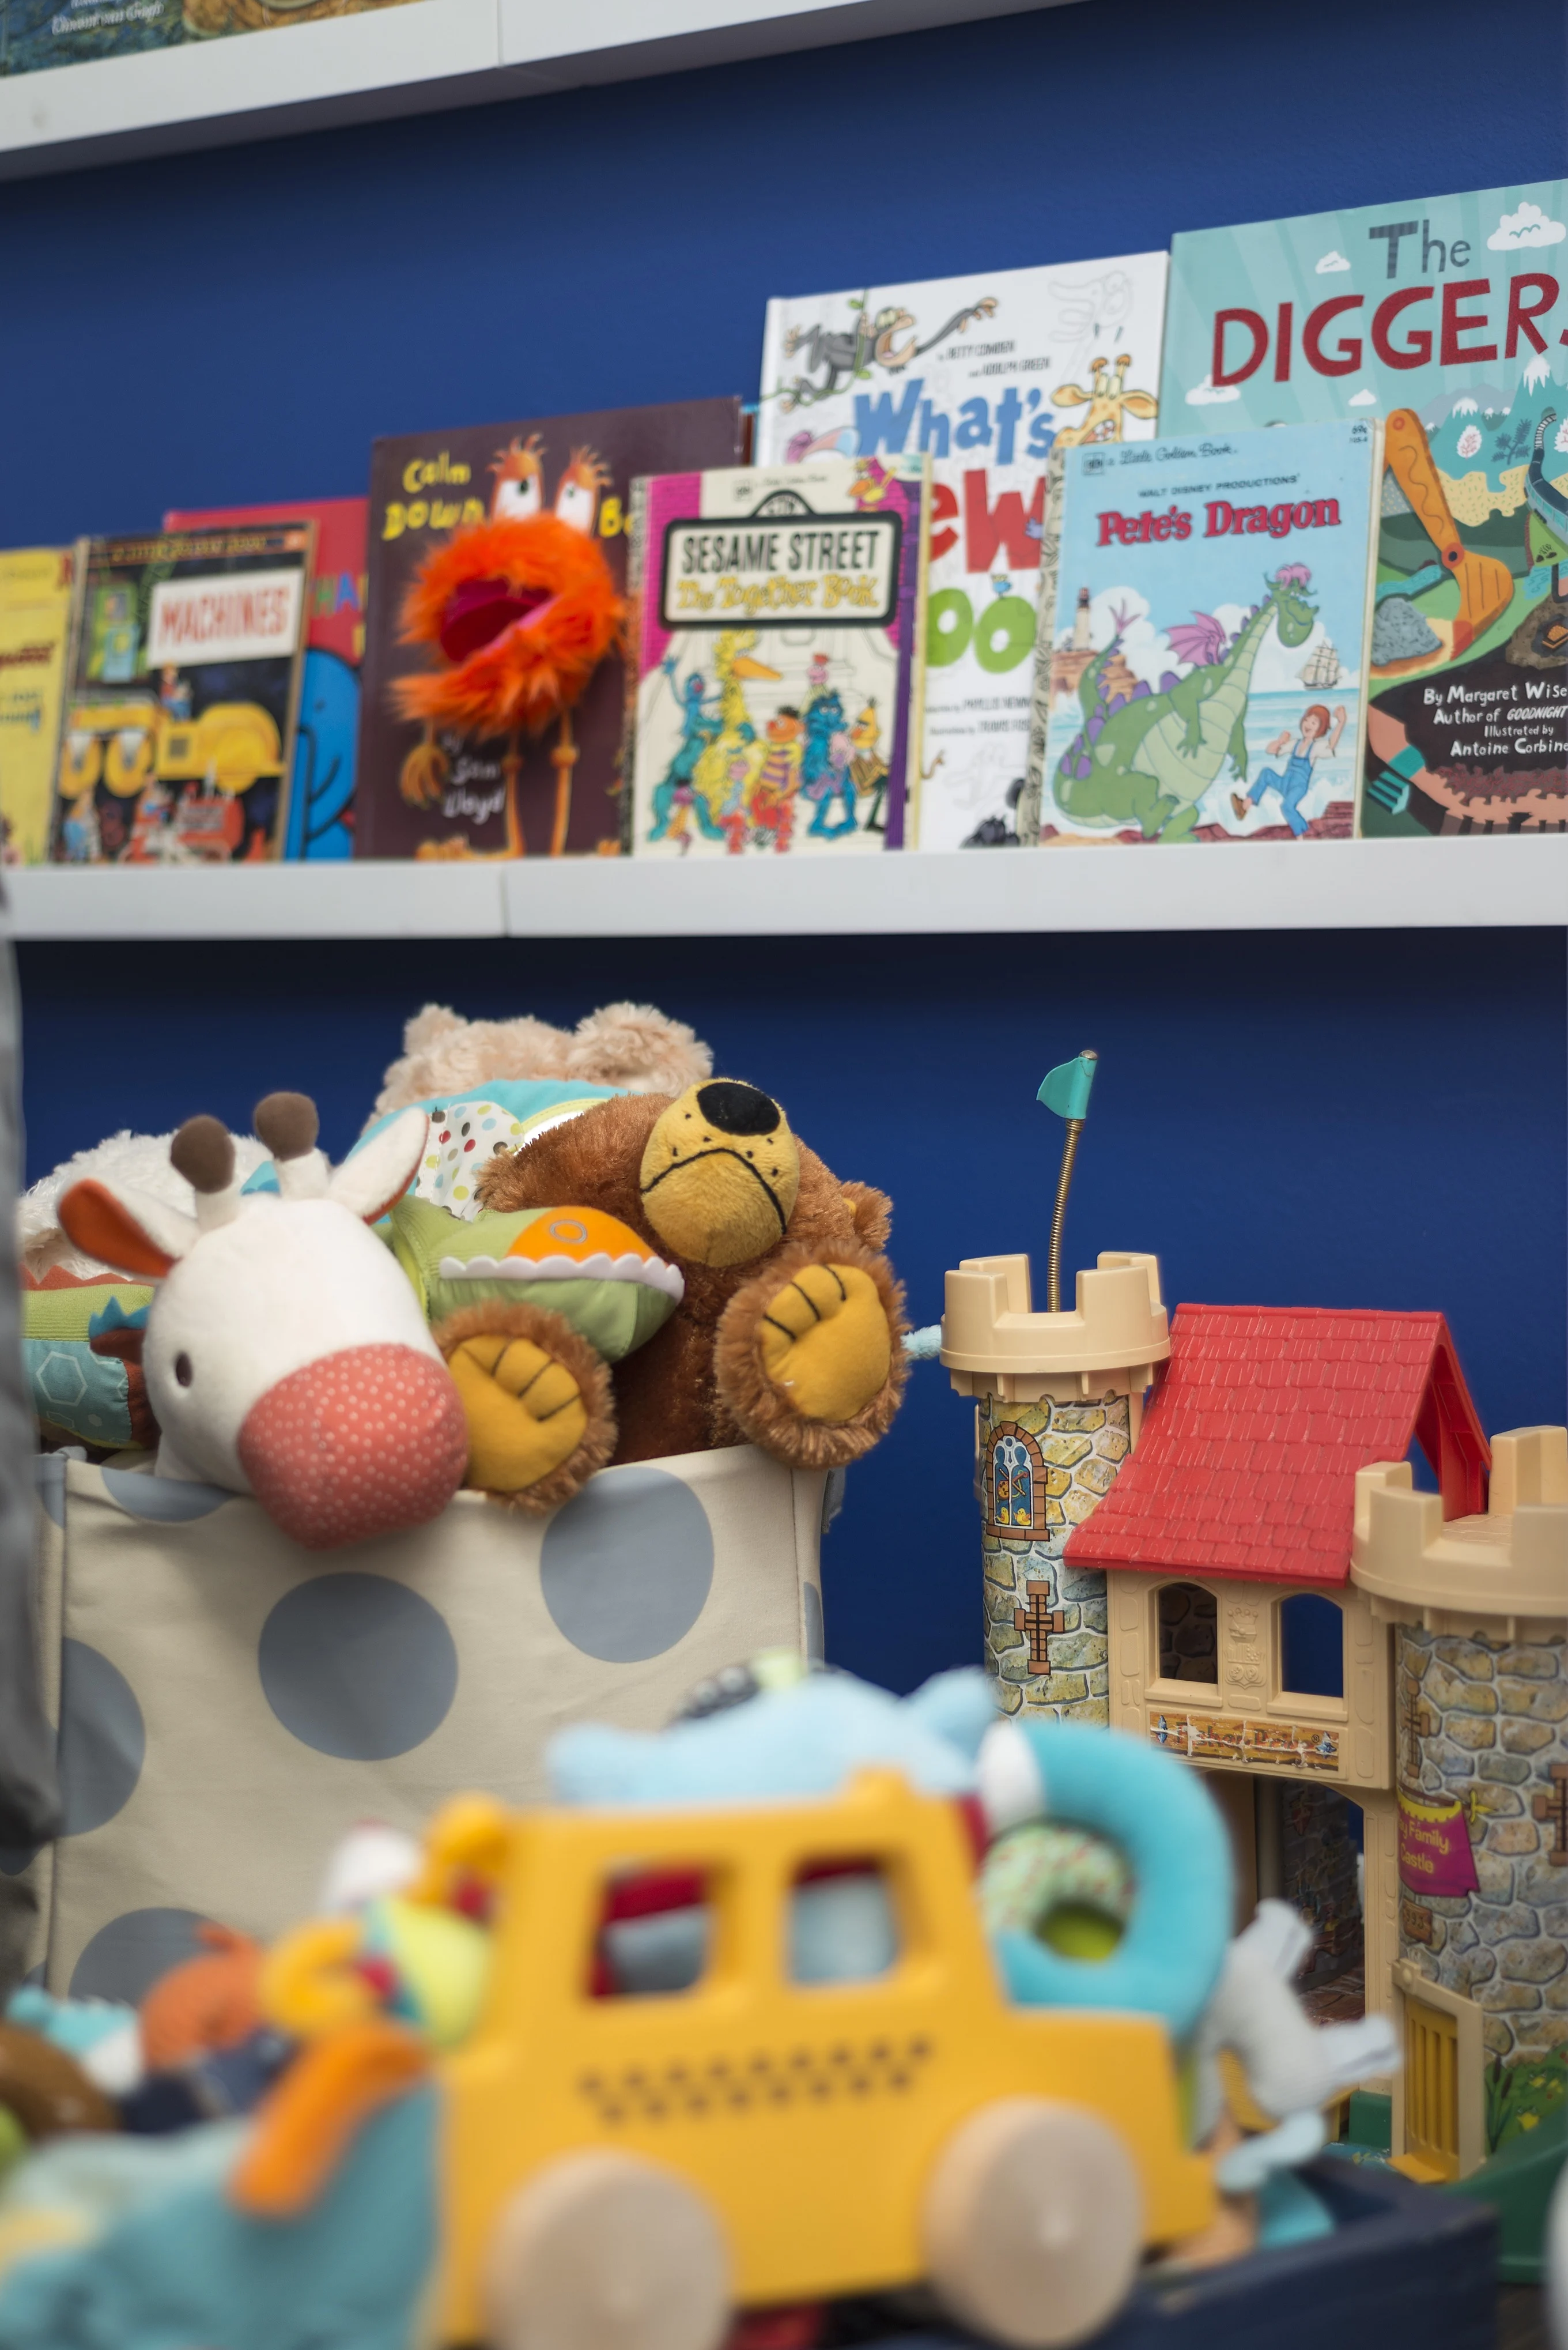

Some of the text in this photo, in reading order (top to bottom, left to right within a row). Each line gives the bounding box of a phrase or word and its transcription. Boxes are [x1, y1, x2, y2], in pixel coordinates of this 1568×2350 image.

[1369, 219, 1471, 279] The
[853, 378, 1059, 466] What's
[403, 452, 471, 493] Calm
[1120, 449, 1152, 465] Little
[1155, 447, 1196, 461] Golden
[1138, 488, 1166, 497] WALT
[1172, 484, 1210, 495] DISNEY
[1097, 497, 1341, 546] Pete's Dragon
[682, 530, 881, 574] SESAME STREET
[677, 580, 714, 611] The
[717, 575, 818, 617] Together
[159, 586, 290, 646] MACHINES
[1423, 681, 1567, 707] By Margaret Wise
[1433, 705, 1568, 725] Author of GOODNIGHT
[1484, 724, 1554, 738] Illustrated by
[1450, 740, 1509, 757] Antoine
[1409, 1820, 1450, 1855] Family
[1401, 1843, 1434, 1873] Castle
